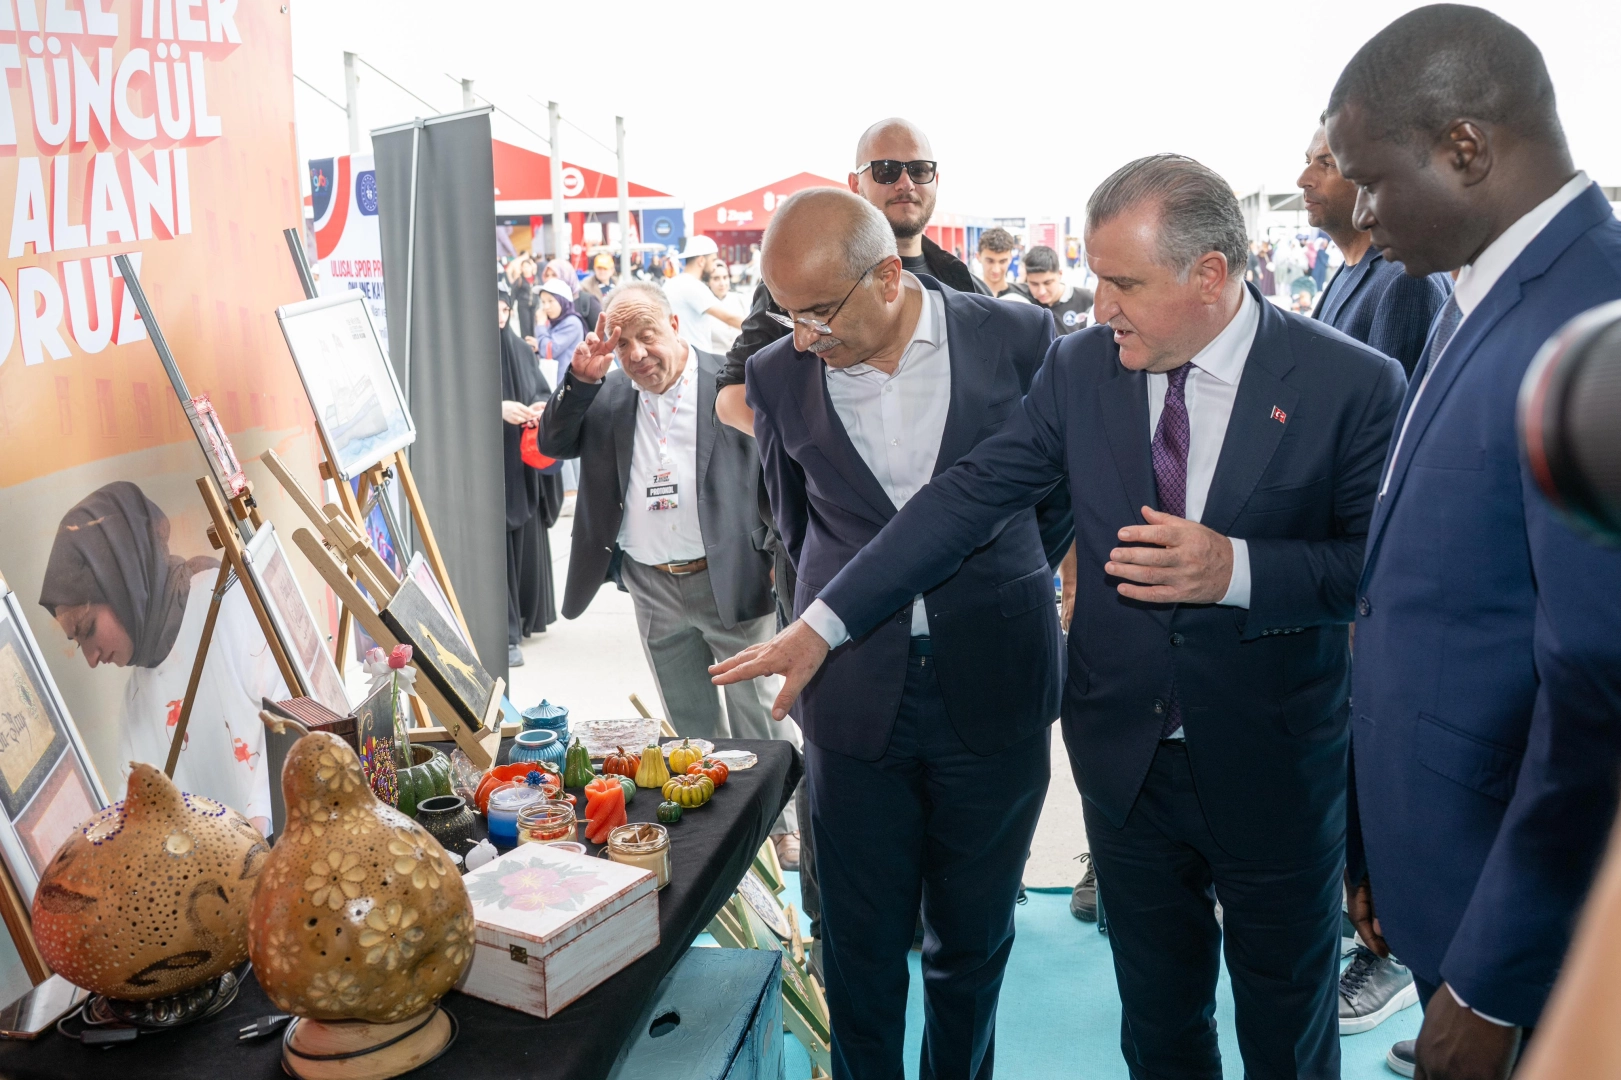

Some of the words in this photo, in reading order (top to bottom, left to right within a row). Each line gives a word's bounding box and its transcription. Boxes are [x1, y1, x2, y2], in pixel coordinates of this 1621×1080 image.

[8, 148, 192, 259] ALANI
[331, 260, 354, 277] ULUSAL
[355, 260, 372, 277] SPOR
[373, 260, 383, 277] PR
